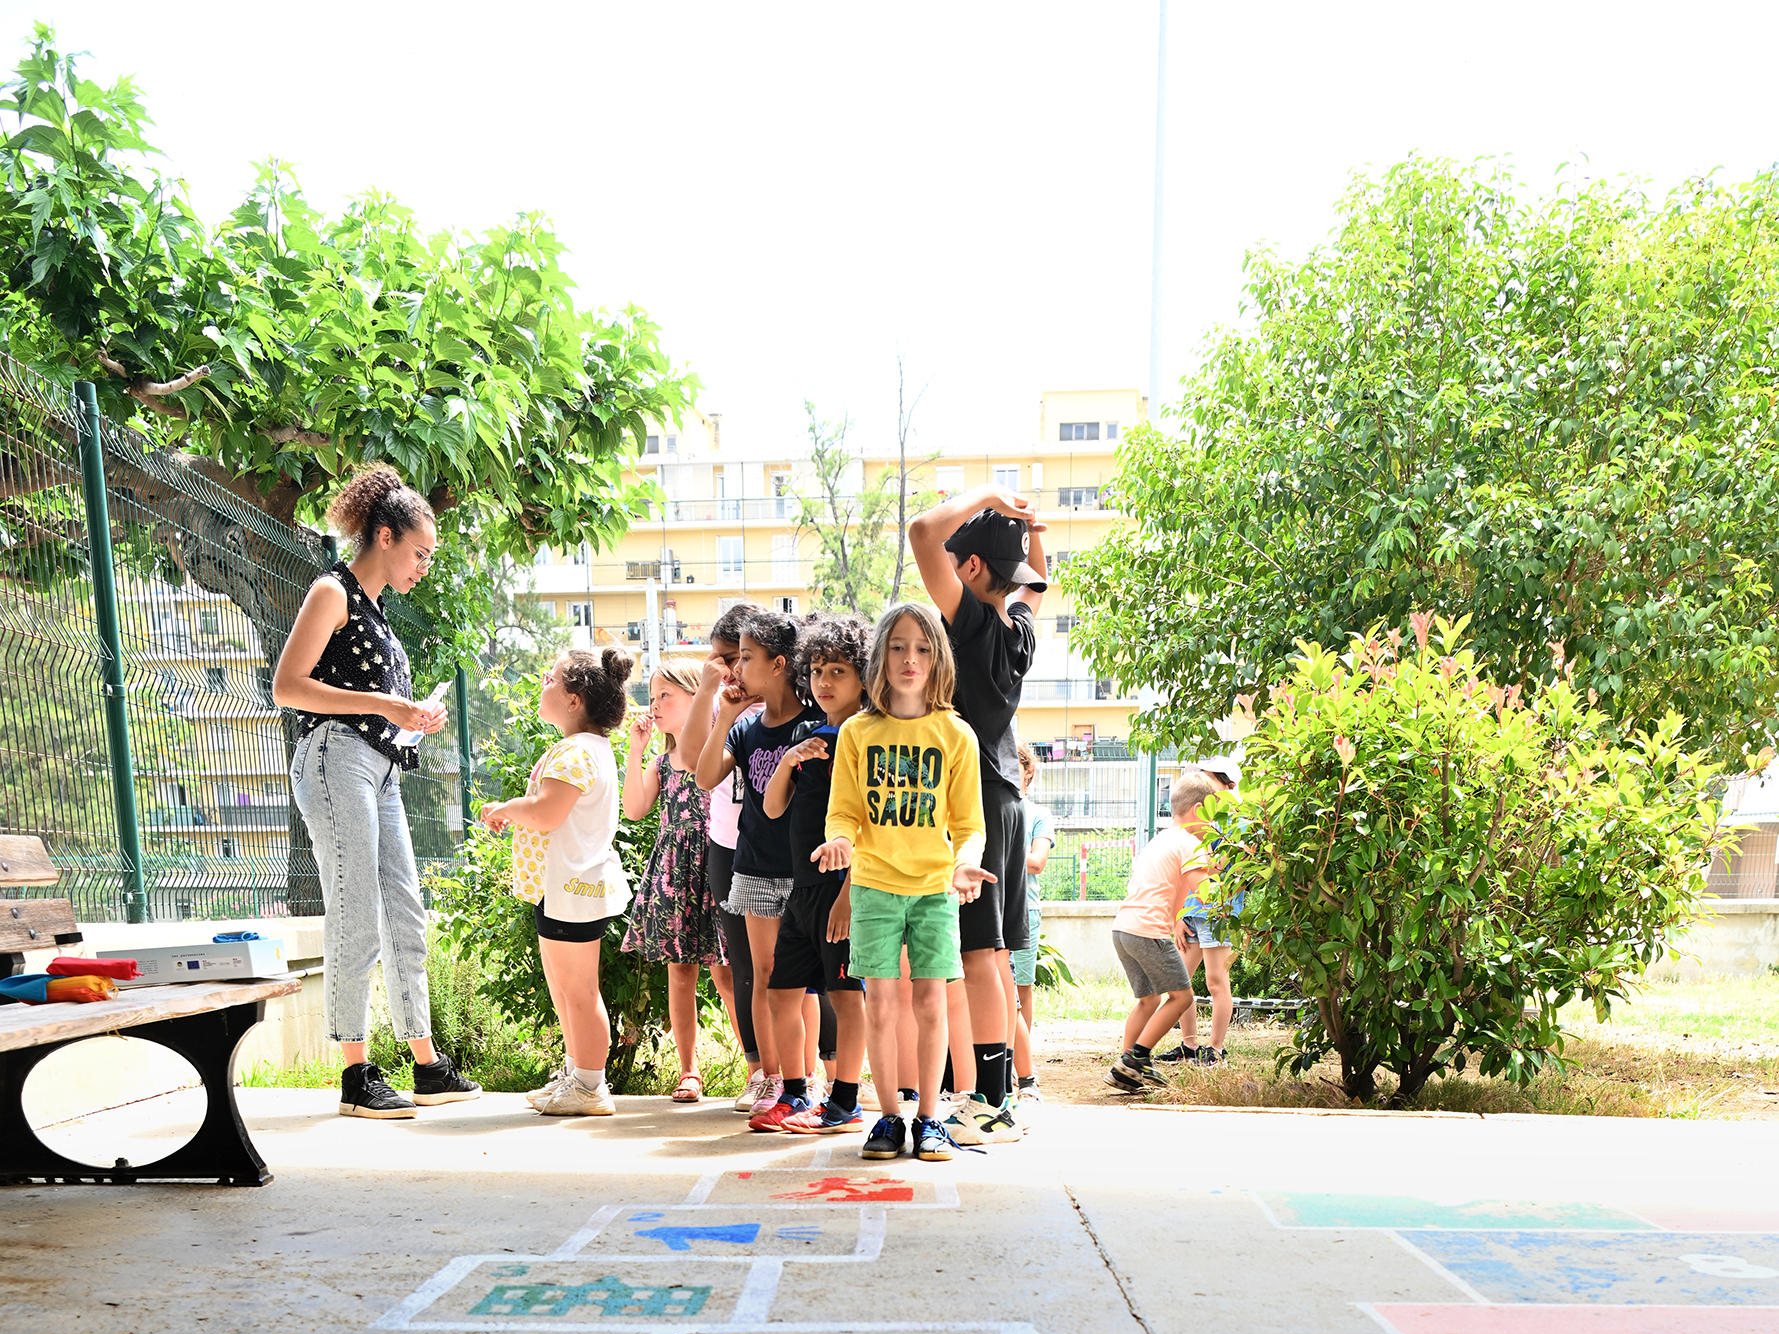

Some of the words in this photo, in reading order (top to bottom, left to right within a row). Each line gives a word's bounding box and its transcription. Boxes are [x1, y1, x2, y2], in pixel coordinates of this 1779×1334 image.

[867, 745, 943, 790] DINO
[867, 790, 936, 827] SAUR
[627, 1212, 665, 1222] 2
[491, 1264, 531, 1278] 3
[1678, 1253, 1779, 1279] 8
